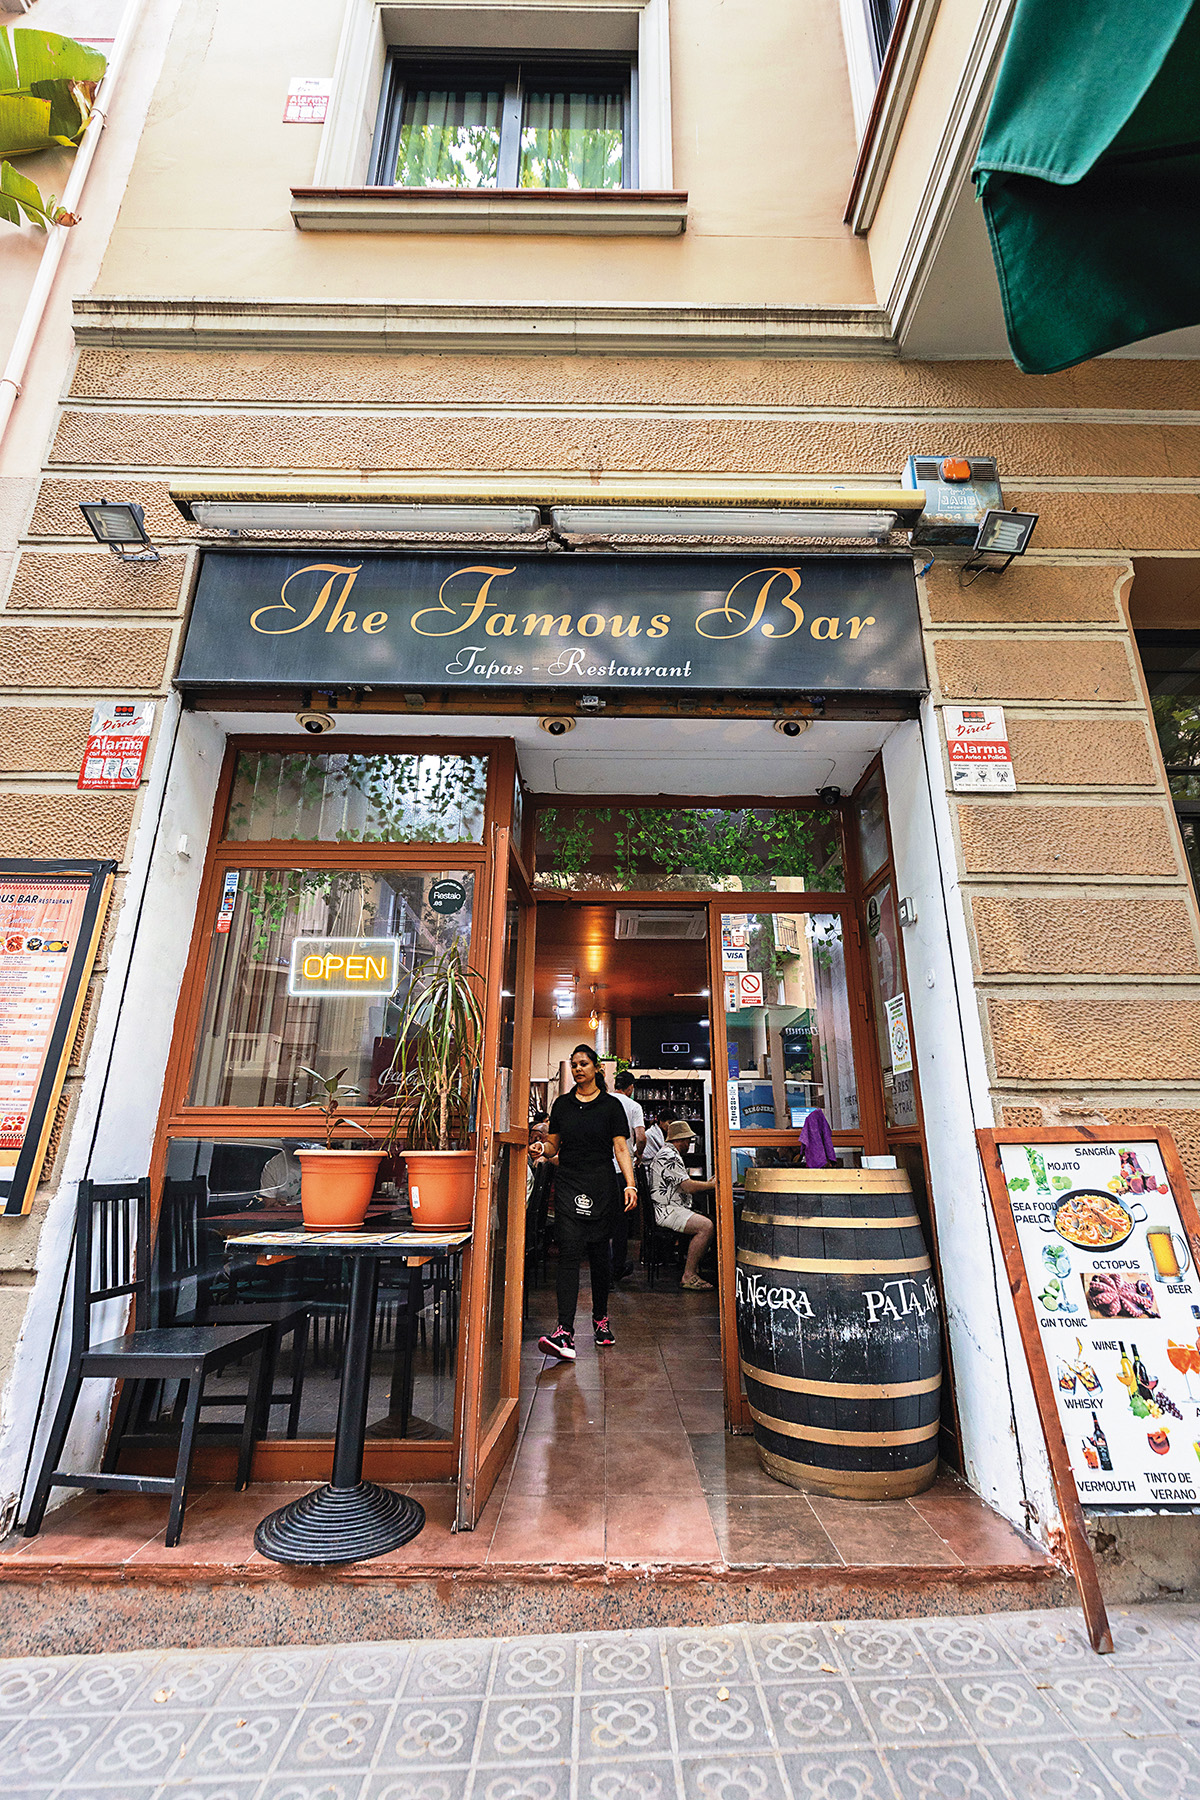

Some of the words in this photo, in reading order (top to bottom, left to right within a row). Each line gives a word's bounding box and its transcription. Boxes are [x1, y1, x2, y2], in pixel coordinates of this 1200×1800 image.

[249, 562, 389, 635] The
[409, 565, 671, 639] Famous
[695, 566, 877, 640] Bar
[445, 646, 524, 679] Tapas
[547, 647, 692, 678] Restaurant
[101, 716, 143, 732] Direct
[955, 721, 996, 737] Direct
[90, 737, 143, 750] Alarma
[952, 743, 1007, 754] Alarma
[0, 894, 15, 904] US
[17, 894, 39, 904] BAR
[303, 954, 388, 982] OPEN
[1074, 1146, 1116, 1157] SANGRÍA
[1047, 1161, 1080, 1171] MOJITO
[1013, 1202, 1032, 1211] SEA
[1033, 1202, 1058, 1211] FOOD
[1092, 1260, 1140, 1270] OCTOPUS
[1167, 1284, 1193, 1295] BEER
[746, 1274, 816, 1319] NEGRA
[861, 1278, 926, 1323] PATA
[1040, 1318, 1057, 1328] GIN
[1058, 1318, 1088, 1328] TONIC
[1091, 1340, 1118, 1351] WINE
[1063, 1398, 1104, 1409] WHISKY
[1143, 1472, 1177, 1483] TINTO
[1177, 1472, 1193, 1483] DE
[1077, 1480, 1136, 1492] VERMOUTH
[1150, 1488, 1197, 1500] VERANO
